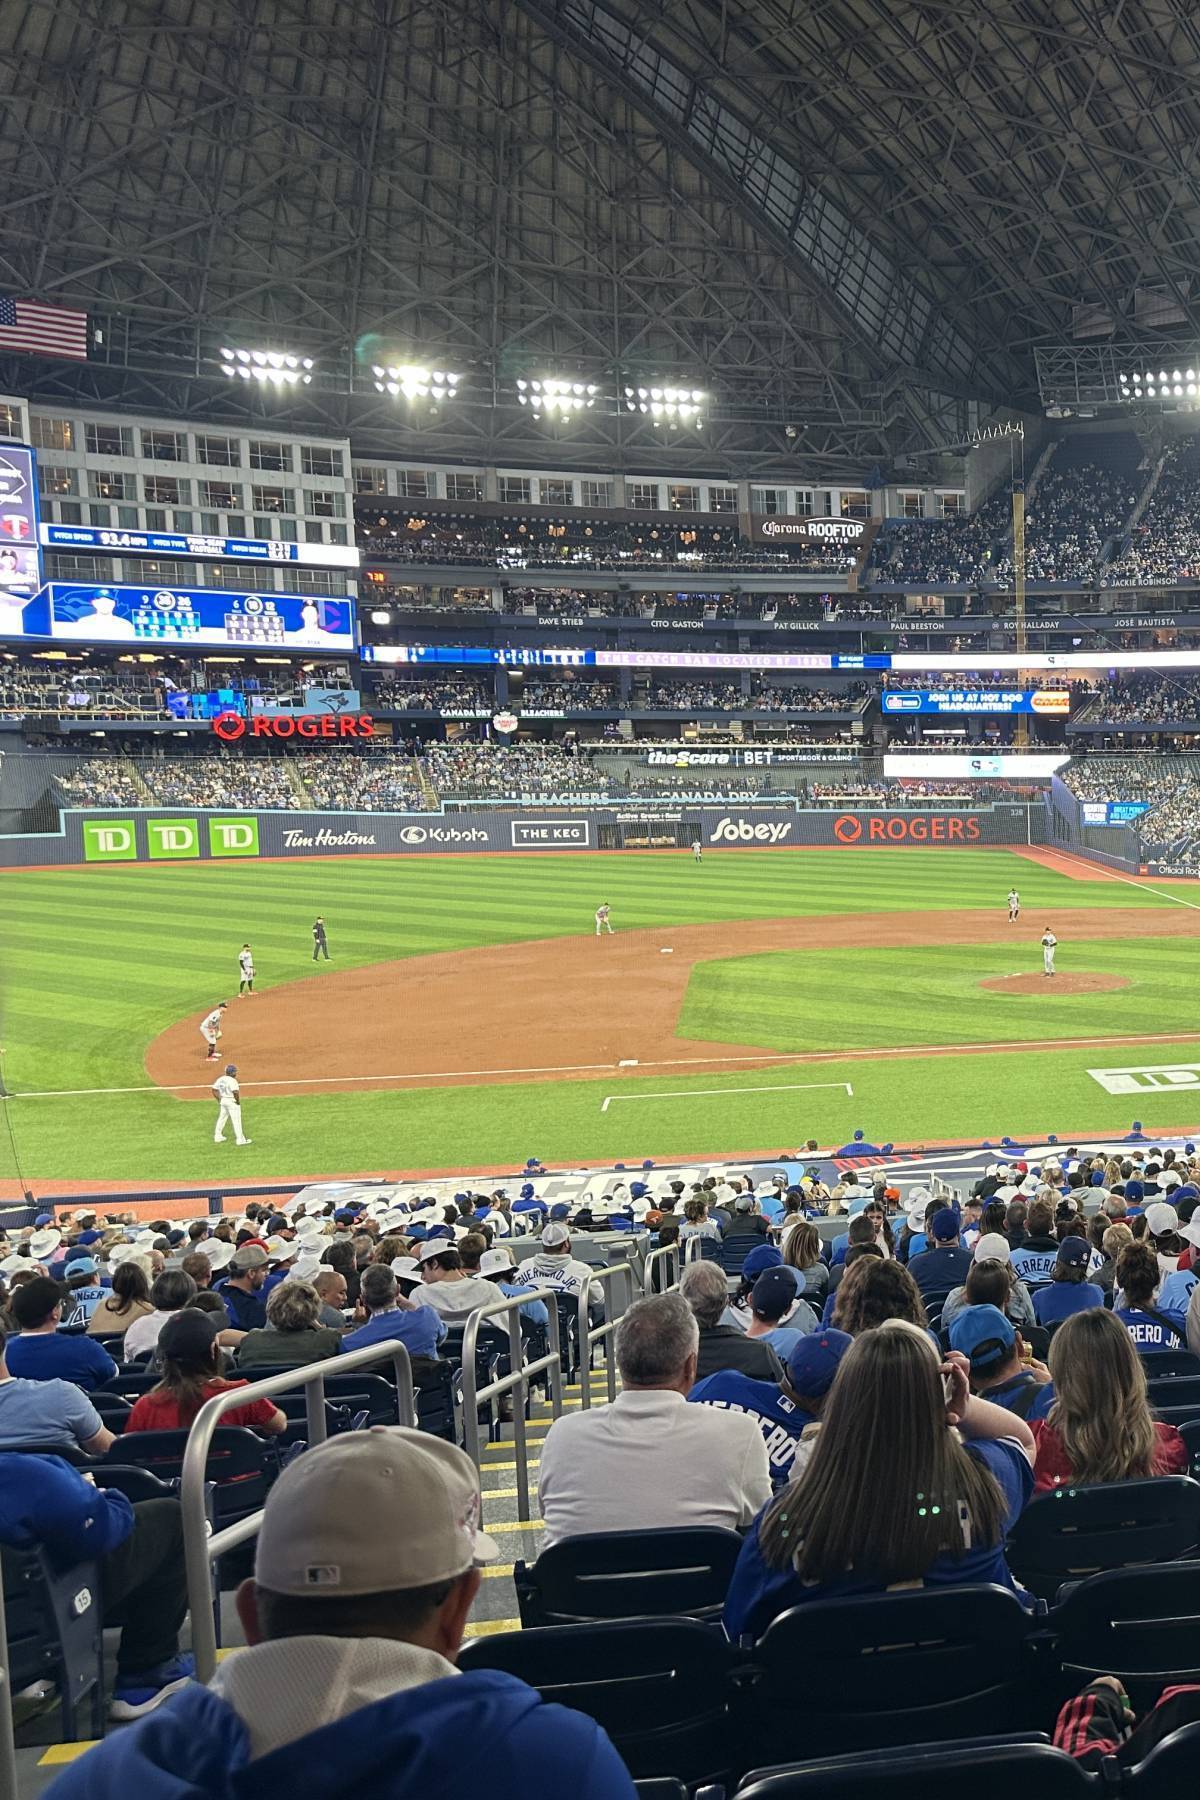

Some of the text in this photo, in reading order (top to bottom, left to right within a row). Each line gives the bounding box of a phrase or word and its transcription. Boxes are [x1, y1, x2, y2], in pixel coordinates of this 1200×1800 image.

[762, 521, 863, 537] Corona ROOFTOP
[101, 532, 130, 546] 93.4
[1110, 577, 1177, 587] JACKIE ROBINSON
[538, 617, 584, 626] DAVE STIEB
[672, 620, 703, 628] GASTON
[774, 622, 819, 630] PAT GILLICK
[1003, 622, 1019, 630] ROY
[1114, 617, 1176, 627] JOSÉ BAUTISTA
[603, 653, 630, 663] THE
[636, 654, 678, 664] CATCH
[684, 655, 710, 664] BAR
[928, 694, 949, 702] JOIN
[951, 694, 965, 702] US
[967, 694, 980, 702] AT
[981, 694, 999, 702] HOT
[1002, 694, 1023, 703] DOG
[939, 702, 1012, 711] HEADQUARTERS!
[440, 709, 492, 717] CANADA DRY
[520, 709, 565, 717] BLEACHERS
[253, 715, 375, 737] ROGERS
[647, 751, 730, 766] theScore
[744, 751, 773, 765] BET
[521, 791, 759, 806] BLEACHERS CANADA DRY
[520, 828, 580, 838] THE KEG
[710, 817, 792, 843] Sobeys
[869, 816, 981, 840] ROGERS
[89, 827, 131, 852] TD
[153, 826, 193, 850] TD
[214, 824, 253, 848] TD
[283, 828, 376, 847] Tim Hortons
[429, 827, 489, 842] Kubota
[1159, 866, 1184, 875] Official
[79, 1592, 88, 1608] 15
